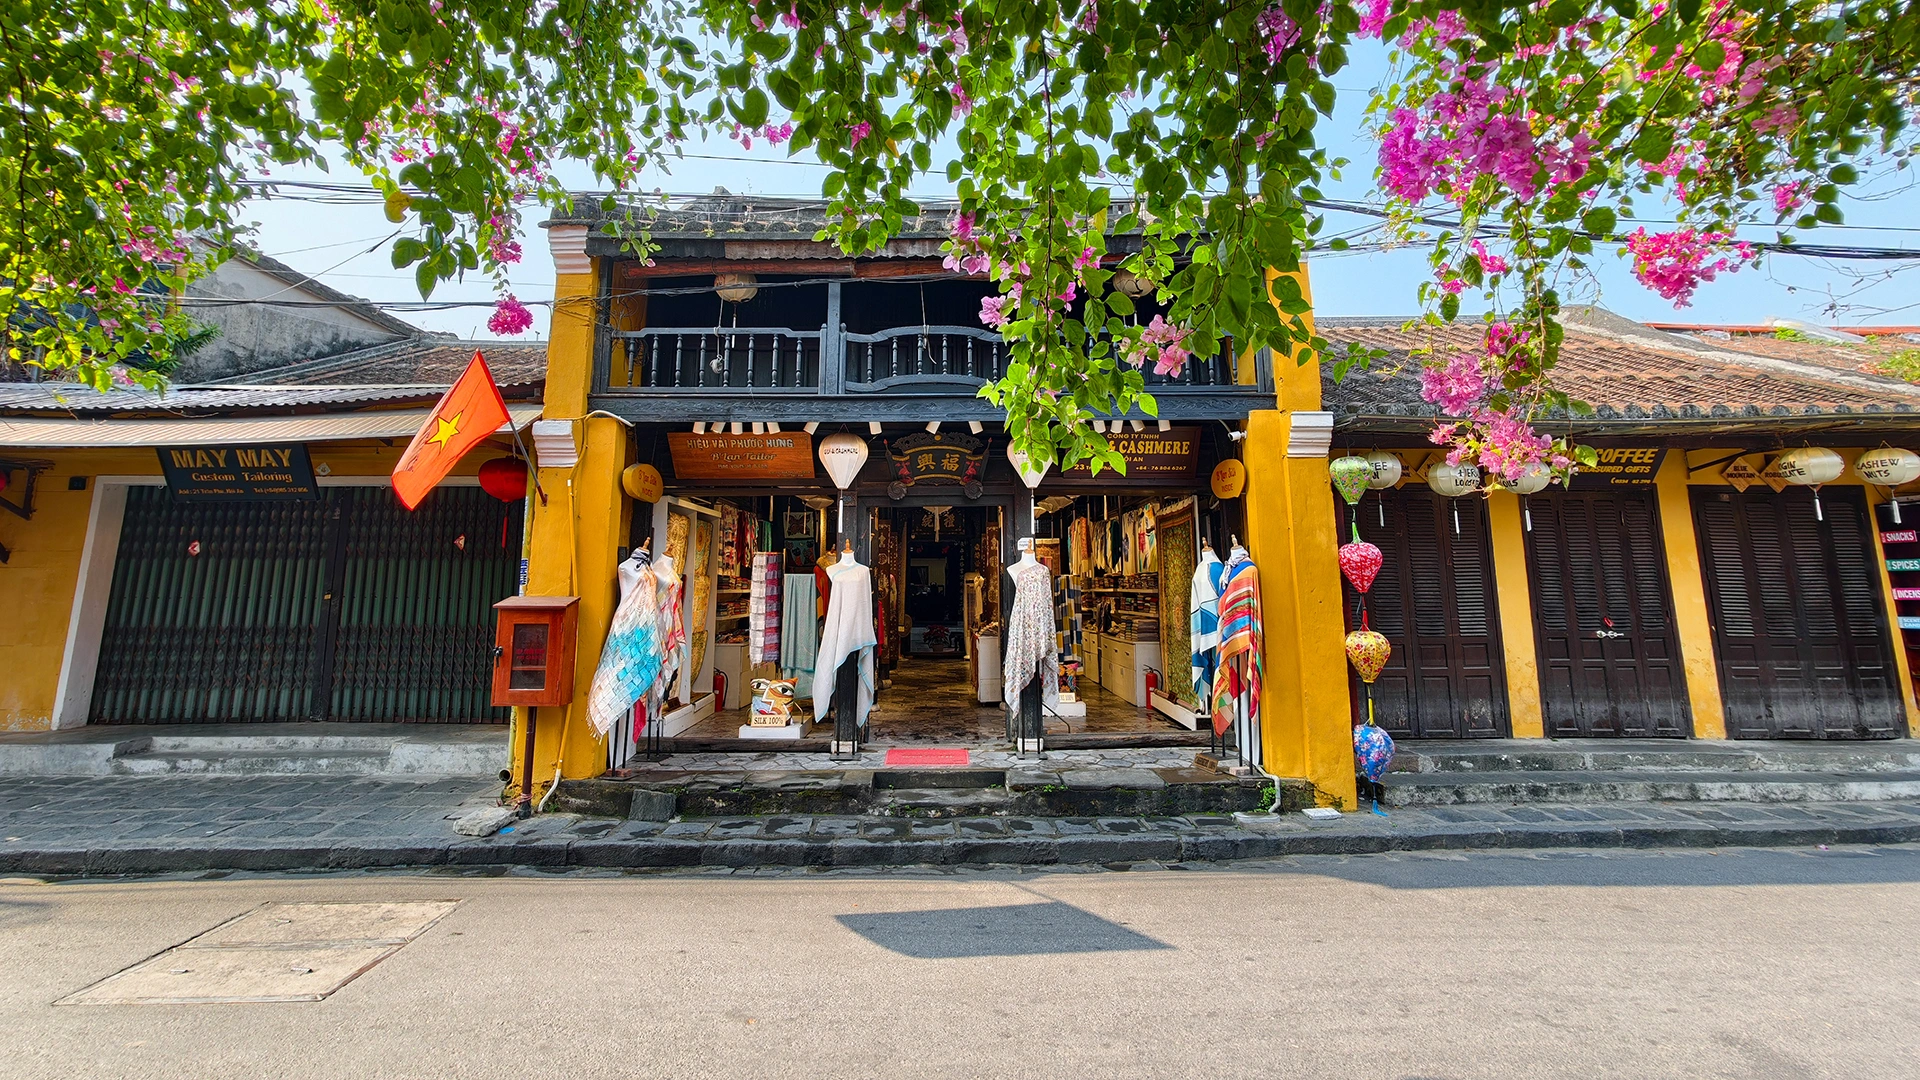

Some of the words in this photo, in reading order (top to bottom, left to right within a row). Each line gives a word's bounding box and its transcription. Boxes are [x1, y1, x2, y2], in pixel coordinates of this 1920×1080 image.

[1120, 440, 1190, 455] CASHMERE
[170, 448, 228, 469] MAY
[235, 448, 292, 468] MAY
[744, 452, 778, 461] Tailor
[1073, 463, 1085, 471] 23
[1856, 458, 1900, 471] CASHEW
[1624, 466, 1651, 474] GIFTS
[1864, 469, 1892, 479] NUTS
[191, 472, 236, 482] Custom
[241, 471, 293, 483] Tailoring
[1885, 532, 1915, 542] SNACKS
[1891, 560, 1920, 570] SPICES
[753, 716, 768, 725] SILK
[768, 716, 784, 725] 100%
